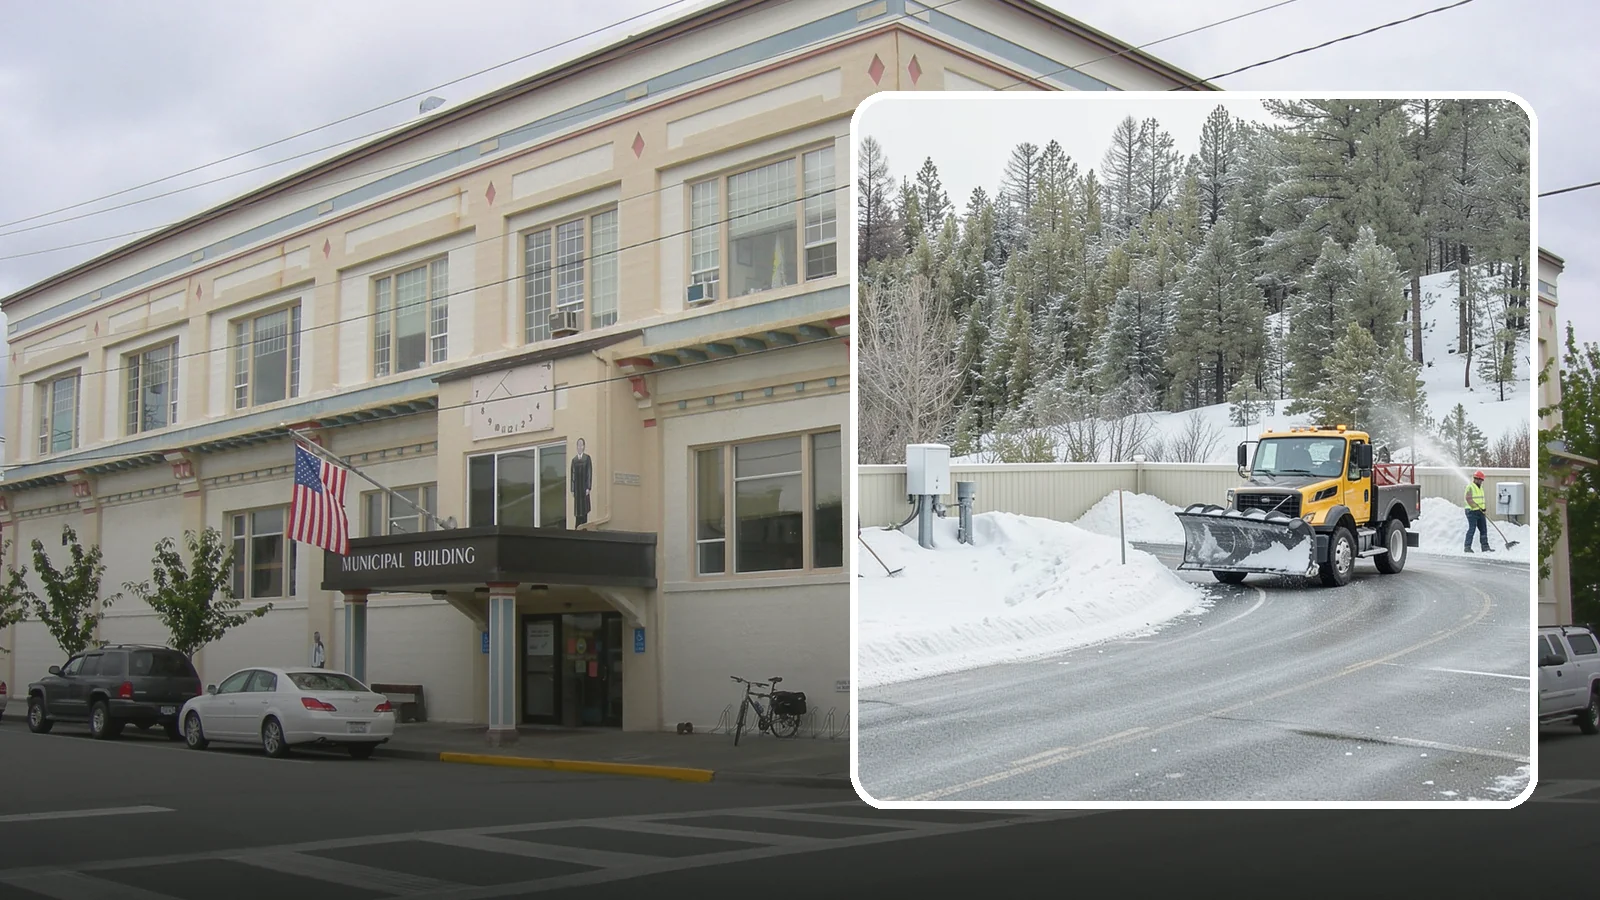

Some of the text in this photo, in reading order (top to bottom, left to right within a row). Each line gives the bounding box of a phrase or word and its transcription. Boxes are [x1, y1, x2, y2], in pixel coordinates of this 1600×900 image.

[494, 423, 500, 432] 10
[507, 425, 513, 433] 12
[342, 546, 476, 572] MUNICIPAL BUILDING
